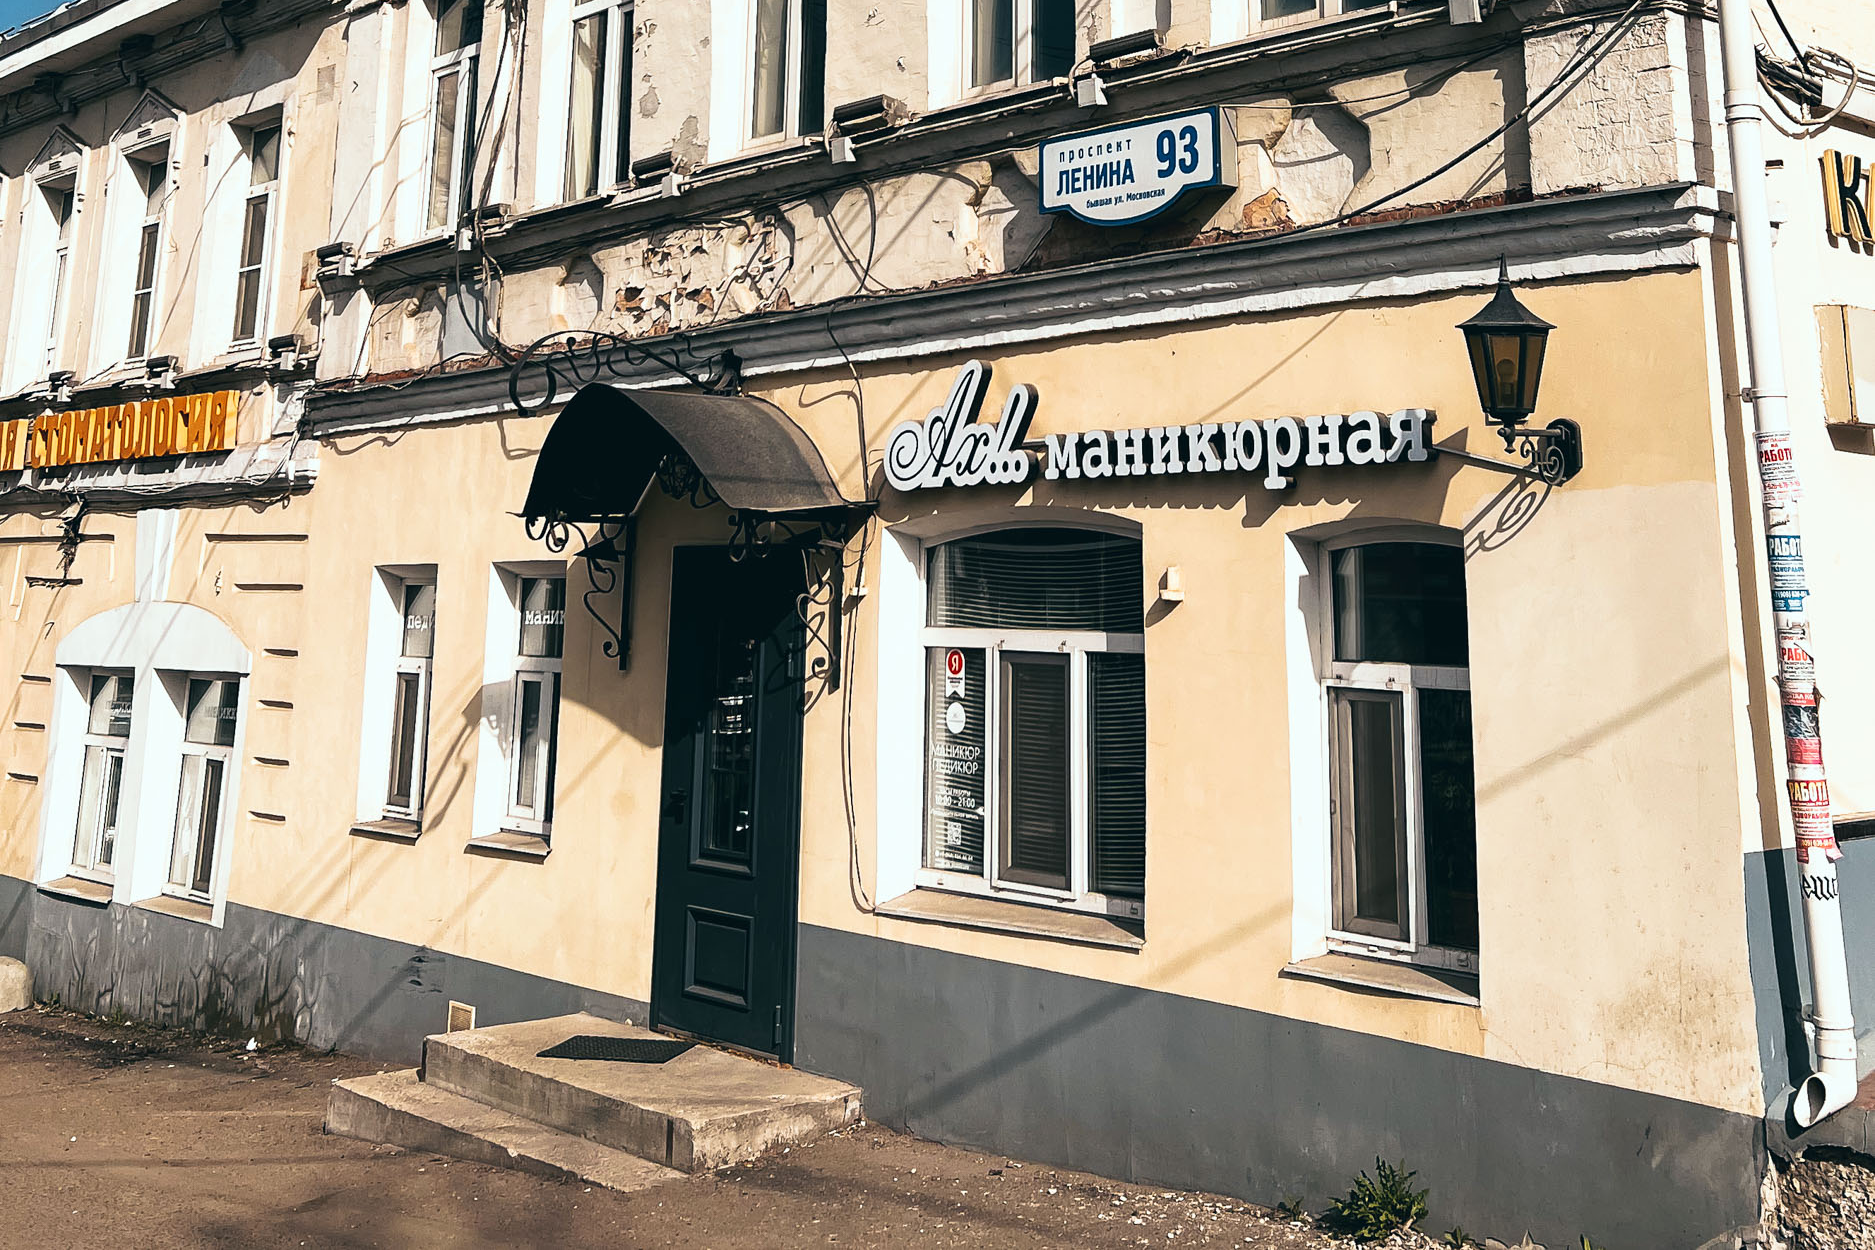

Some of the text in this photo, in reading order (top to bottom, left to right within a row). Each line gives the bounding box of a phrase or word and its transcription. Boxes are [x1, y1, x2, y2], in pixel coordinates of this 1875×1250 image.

[1059, 138, 1132, 163] проспект
[1156, 125, 1199, 179] 93
[1056, 158, 1135, 196] ЛЕНИНА
[1086, 188, 1165, 209] бывшая ул. Московская
[1827, 149, 1875, 243] К
[31, 390, 232, 469] СТОМАТОЛОГИЯ
[1044, 409, 1428, 490] маникюрная
[951, 654, 959, 672] Я
[931, 742, 980, 760] МАНИКЮР
[932, 758, 979, 775] ПЕДИКЮР
[958, 796, 975, 808] 21:00
